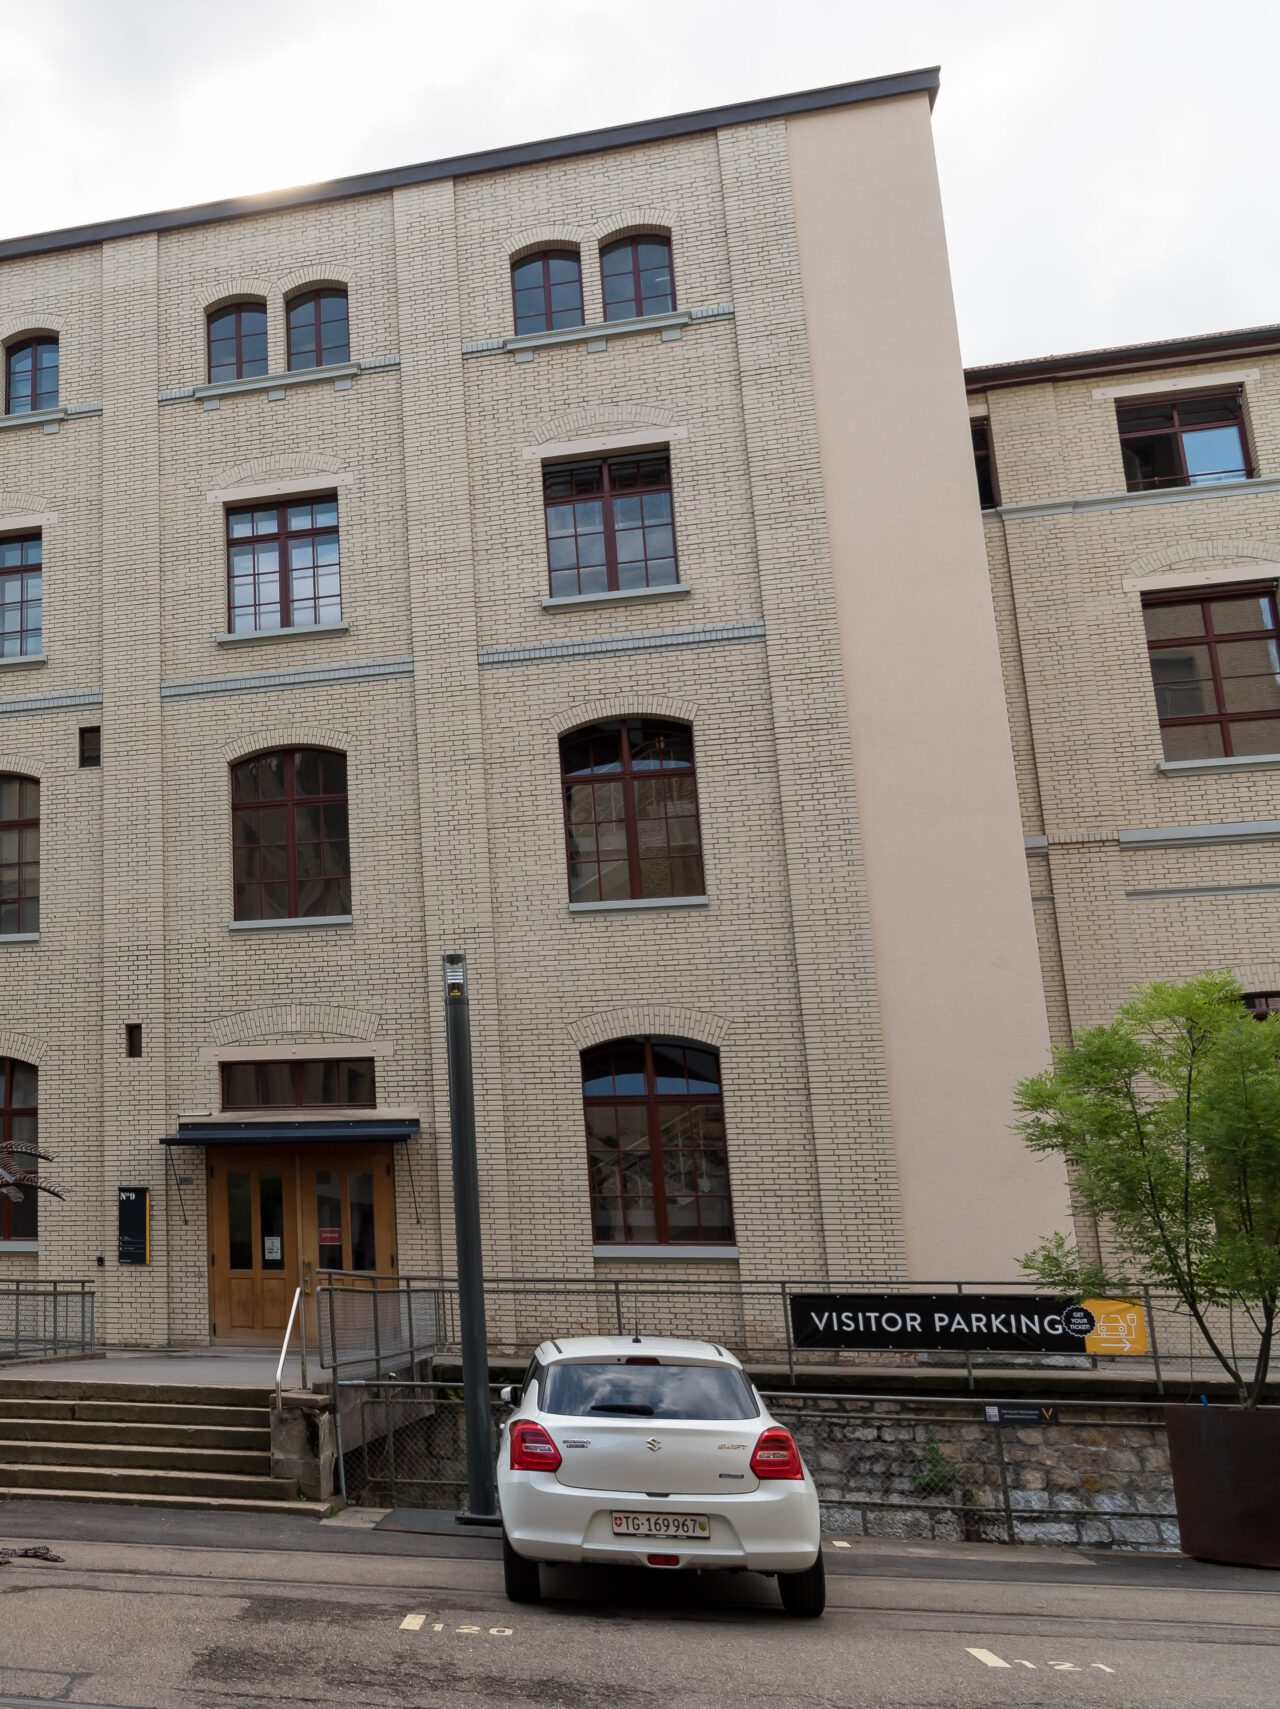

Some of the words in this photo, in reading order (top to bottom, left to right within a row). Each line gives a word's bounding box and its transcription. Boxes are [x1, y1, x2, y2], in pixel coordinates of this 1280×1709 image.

[811, 1312, 922, 1332] VISITOR
[935, 1313, 1063, 1335] PARKING
[432, 1623, 513, 1636] 120
[1014, 1659, 1115, 1673] 121
